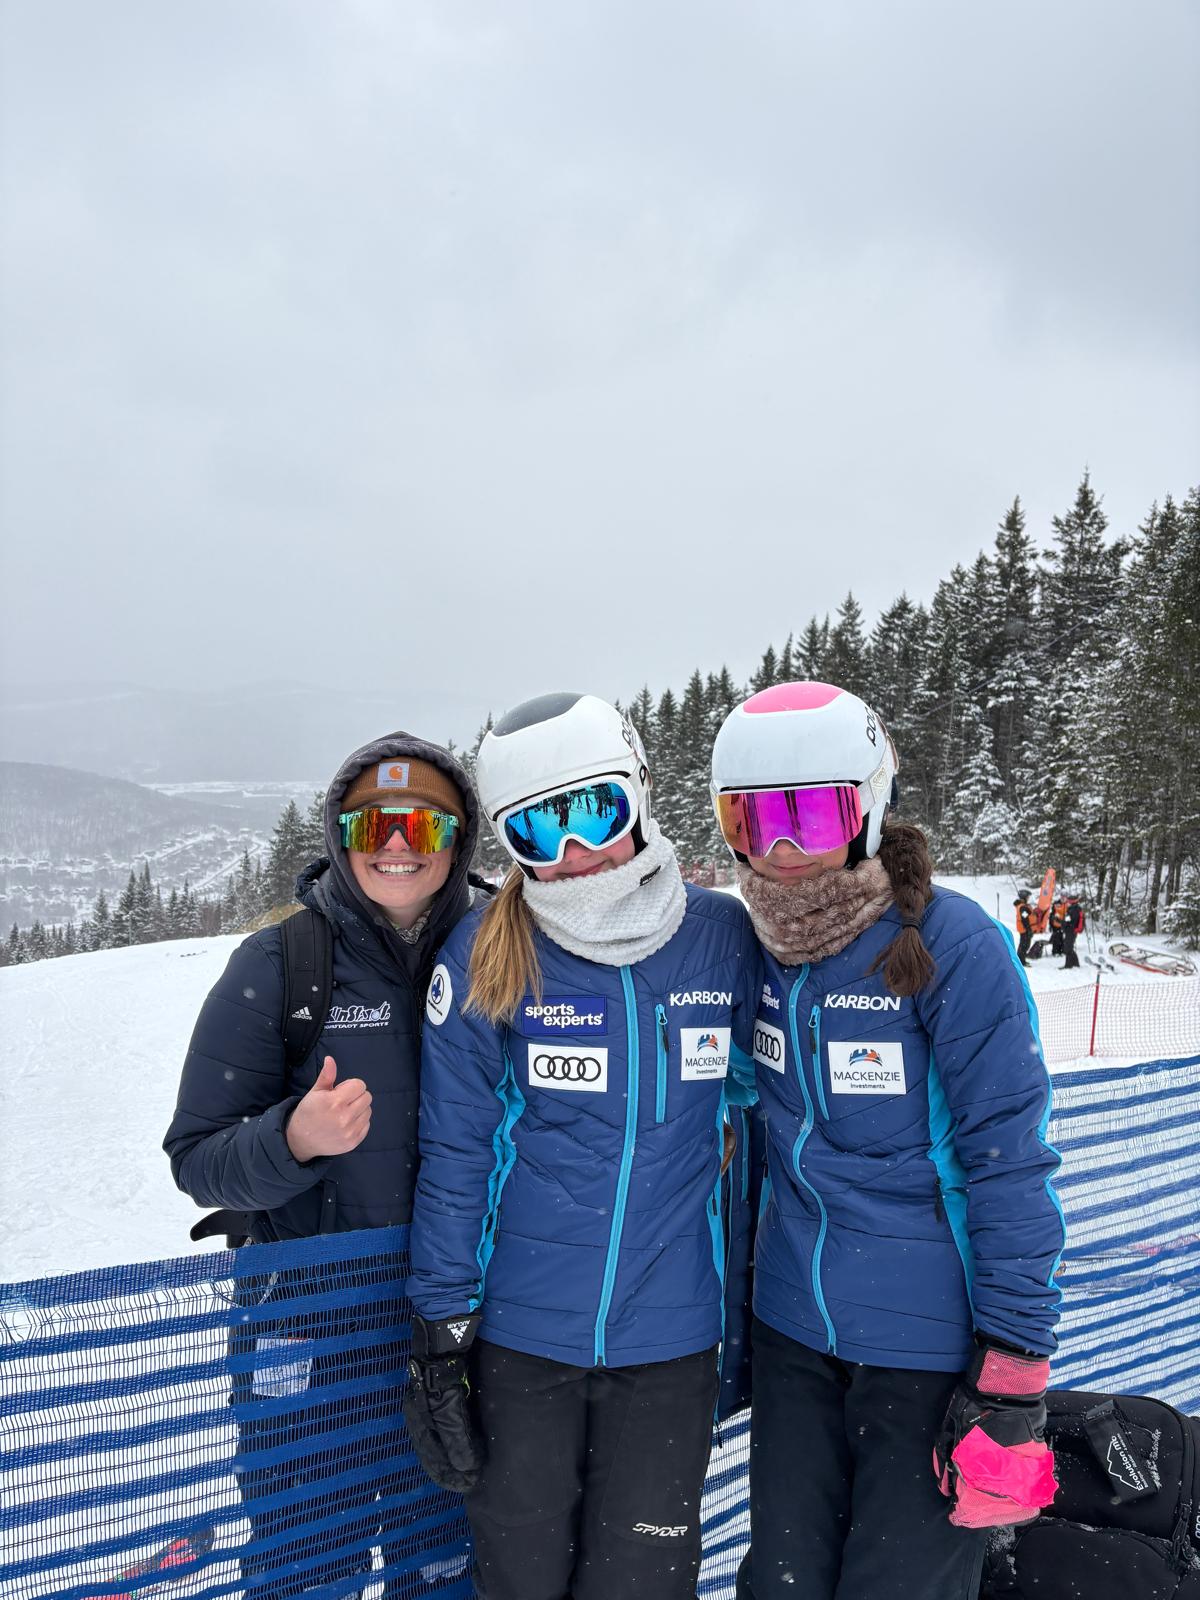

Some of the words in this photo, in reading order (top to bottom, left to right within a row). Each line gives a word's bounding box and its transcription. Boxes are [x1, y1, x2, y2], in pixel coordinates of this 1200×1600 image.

[669, 990, 733, 1007] KARBON
[824, 994, 901, 1011] KARBON
[524, 1003, 575, 1019] sports
[543, 1013, 603, 1029] experts
[685, 1056, 728, 1067] MACKENZIE
[833, 1071, 901, 1082] MACKENZIE
[1119, 1451, 1144, 1491] Evolution
[632, 1522, 689, 1537] SPYDER
